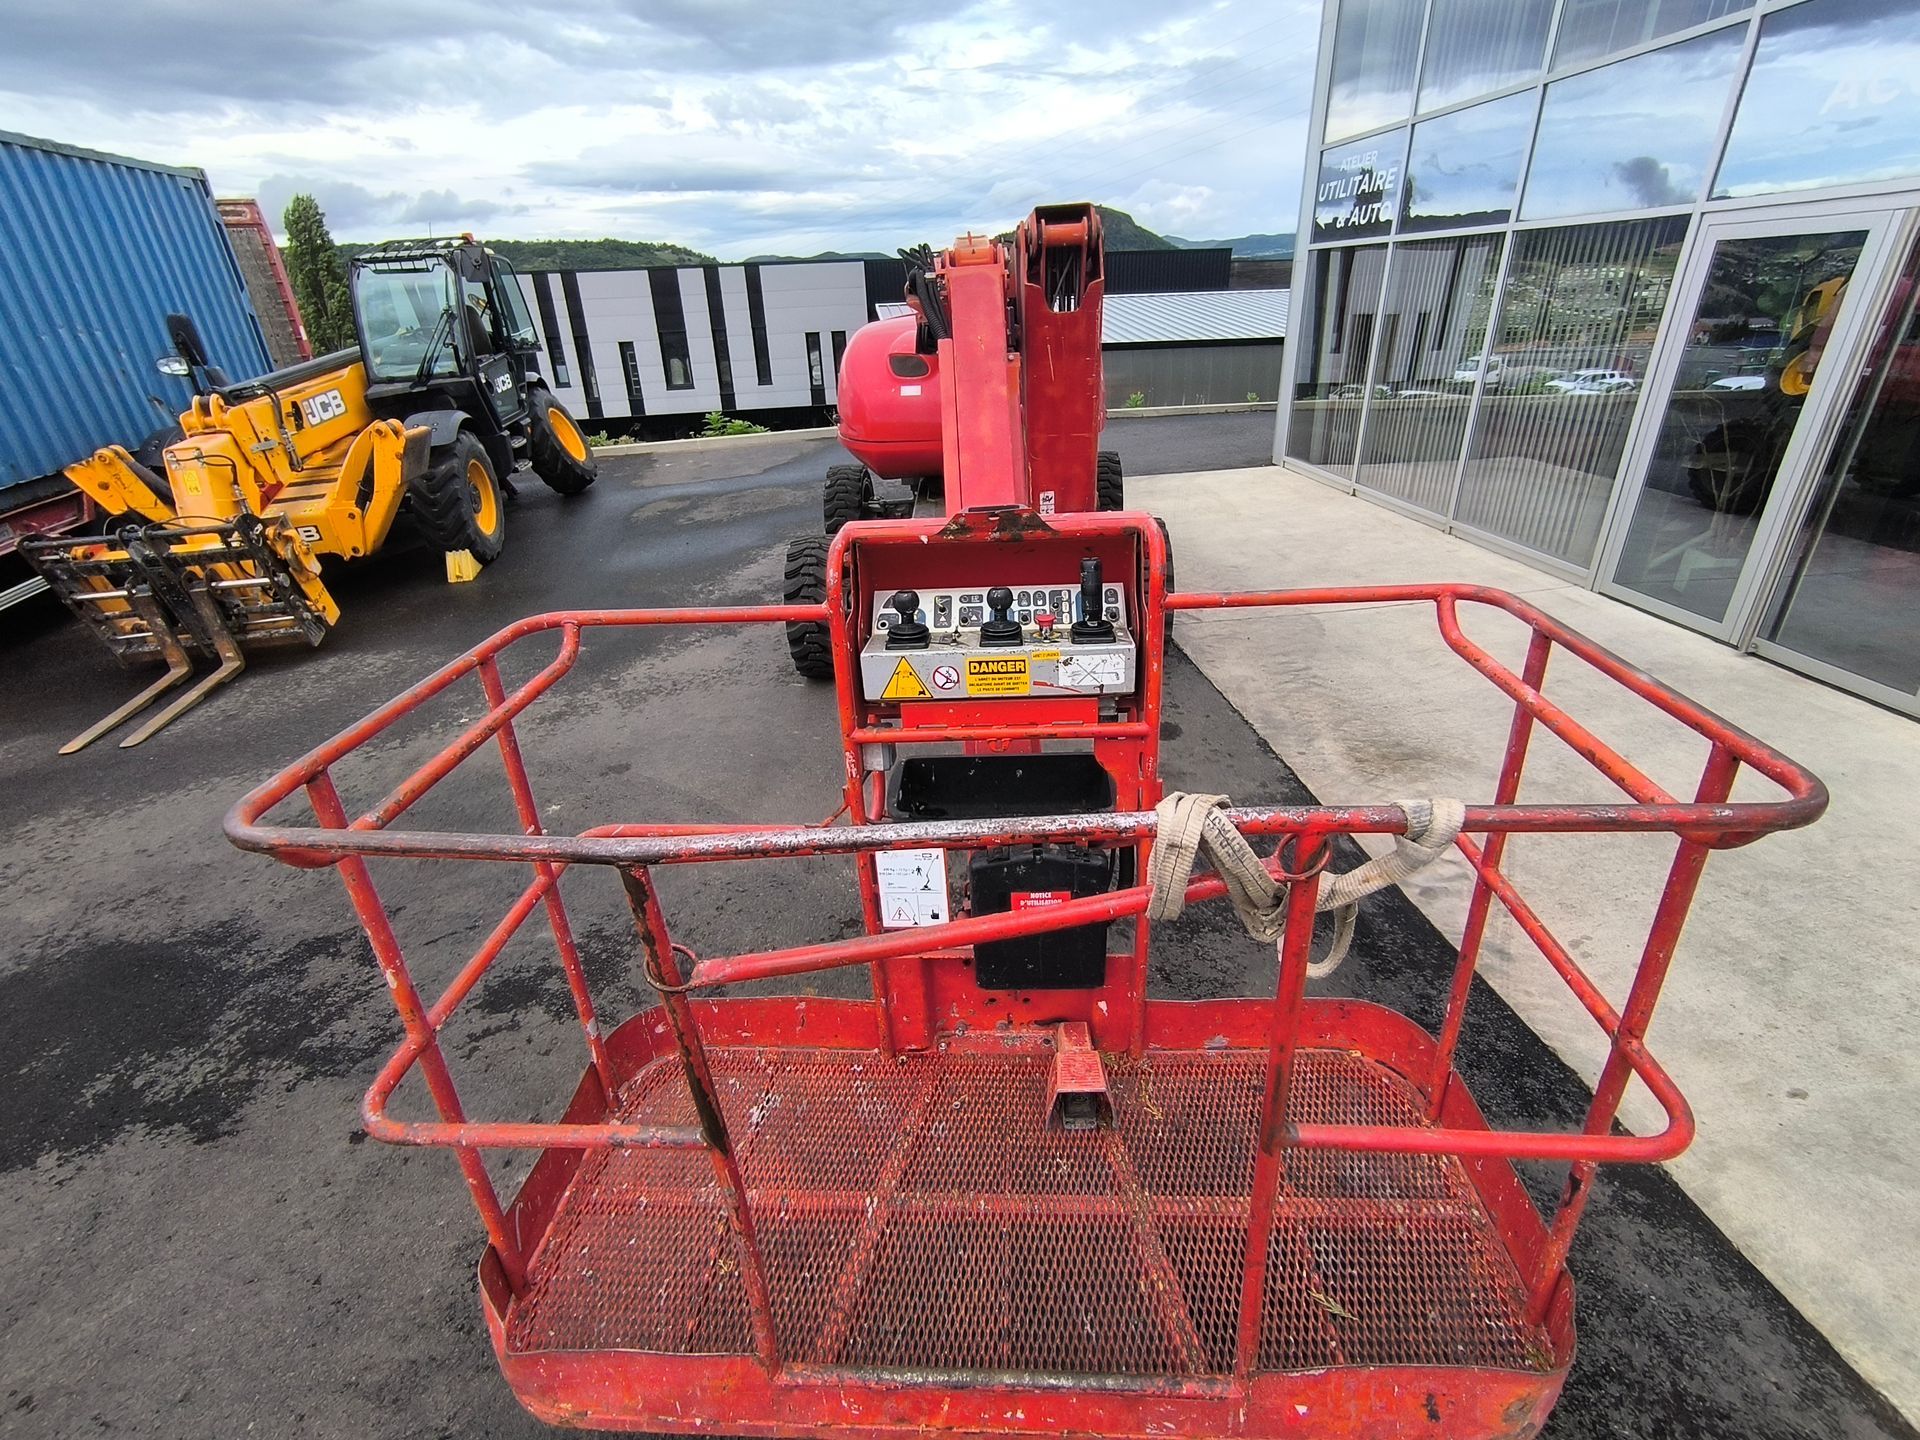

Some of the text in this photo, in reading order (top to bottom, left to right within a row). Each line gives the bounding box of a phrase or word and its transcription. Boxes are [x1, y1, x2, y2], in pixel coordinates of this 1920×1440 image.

[1340, 150, 1378, 172] ATELIER
[1318, 167, 1398, 202] UTILITAIRE
[1336, 201, 1393, 229] & AUTO
[495, 373, 513, 394] JCB
[302, 389, 346, 426] JCB
[970, 661, 1025, 674] DANGER
